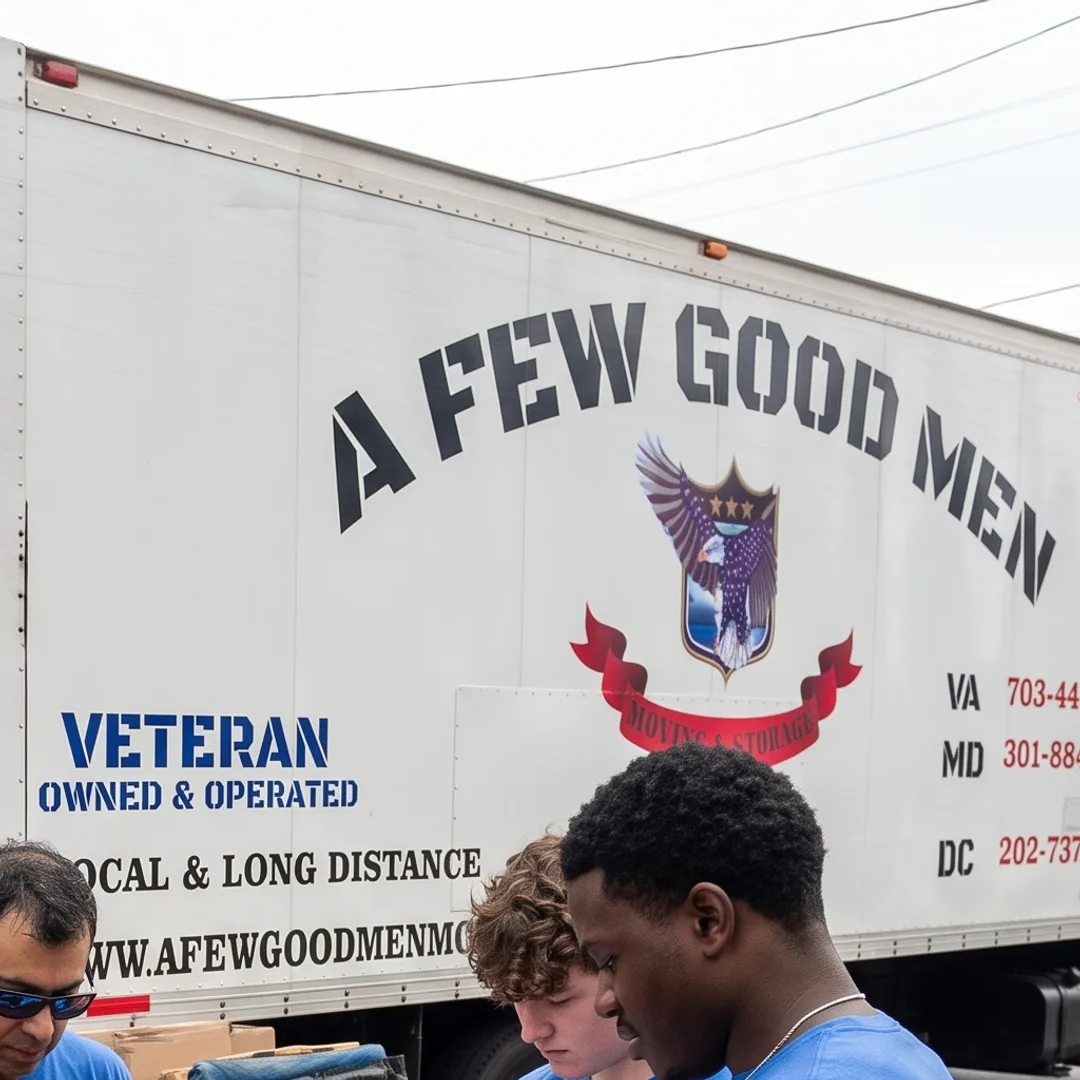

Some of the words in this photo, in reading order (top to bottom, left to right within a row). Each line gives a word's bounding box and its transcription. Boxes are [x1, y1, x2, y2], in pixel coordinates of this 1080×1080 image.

[332, 390, 417, 534] A
[418, 302, 647, 462] FEW
[675, 303, 899, 460] GOOD
[912, 405, 1057, 606] MEN
[947, 672, 981, 711] VA
[1008, 676, 1080, 709] 703-44
[60, 712, 329, 768] VETERAN
[733, 709, 813, 756] STORAGE
[942, 740, 984, 778] MD
[38, 780, 162, 812] OWNED
[172, 780, 194, 810] &
[204, 779, 358, 810] OPERATED
[73, 856, 169, 893] OCAL
[182, 855, 210, 890] &
[222, 852, 317, 888] LONG
[327, 848, 482, 883] DISTANCE
[937, 839, 974, 878] DC
